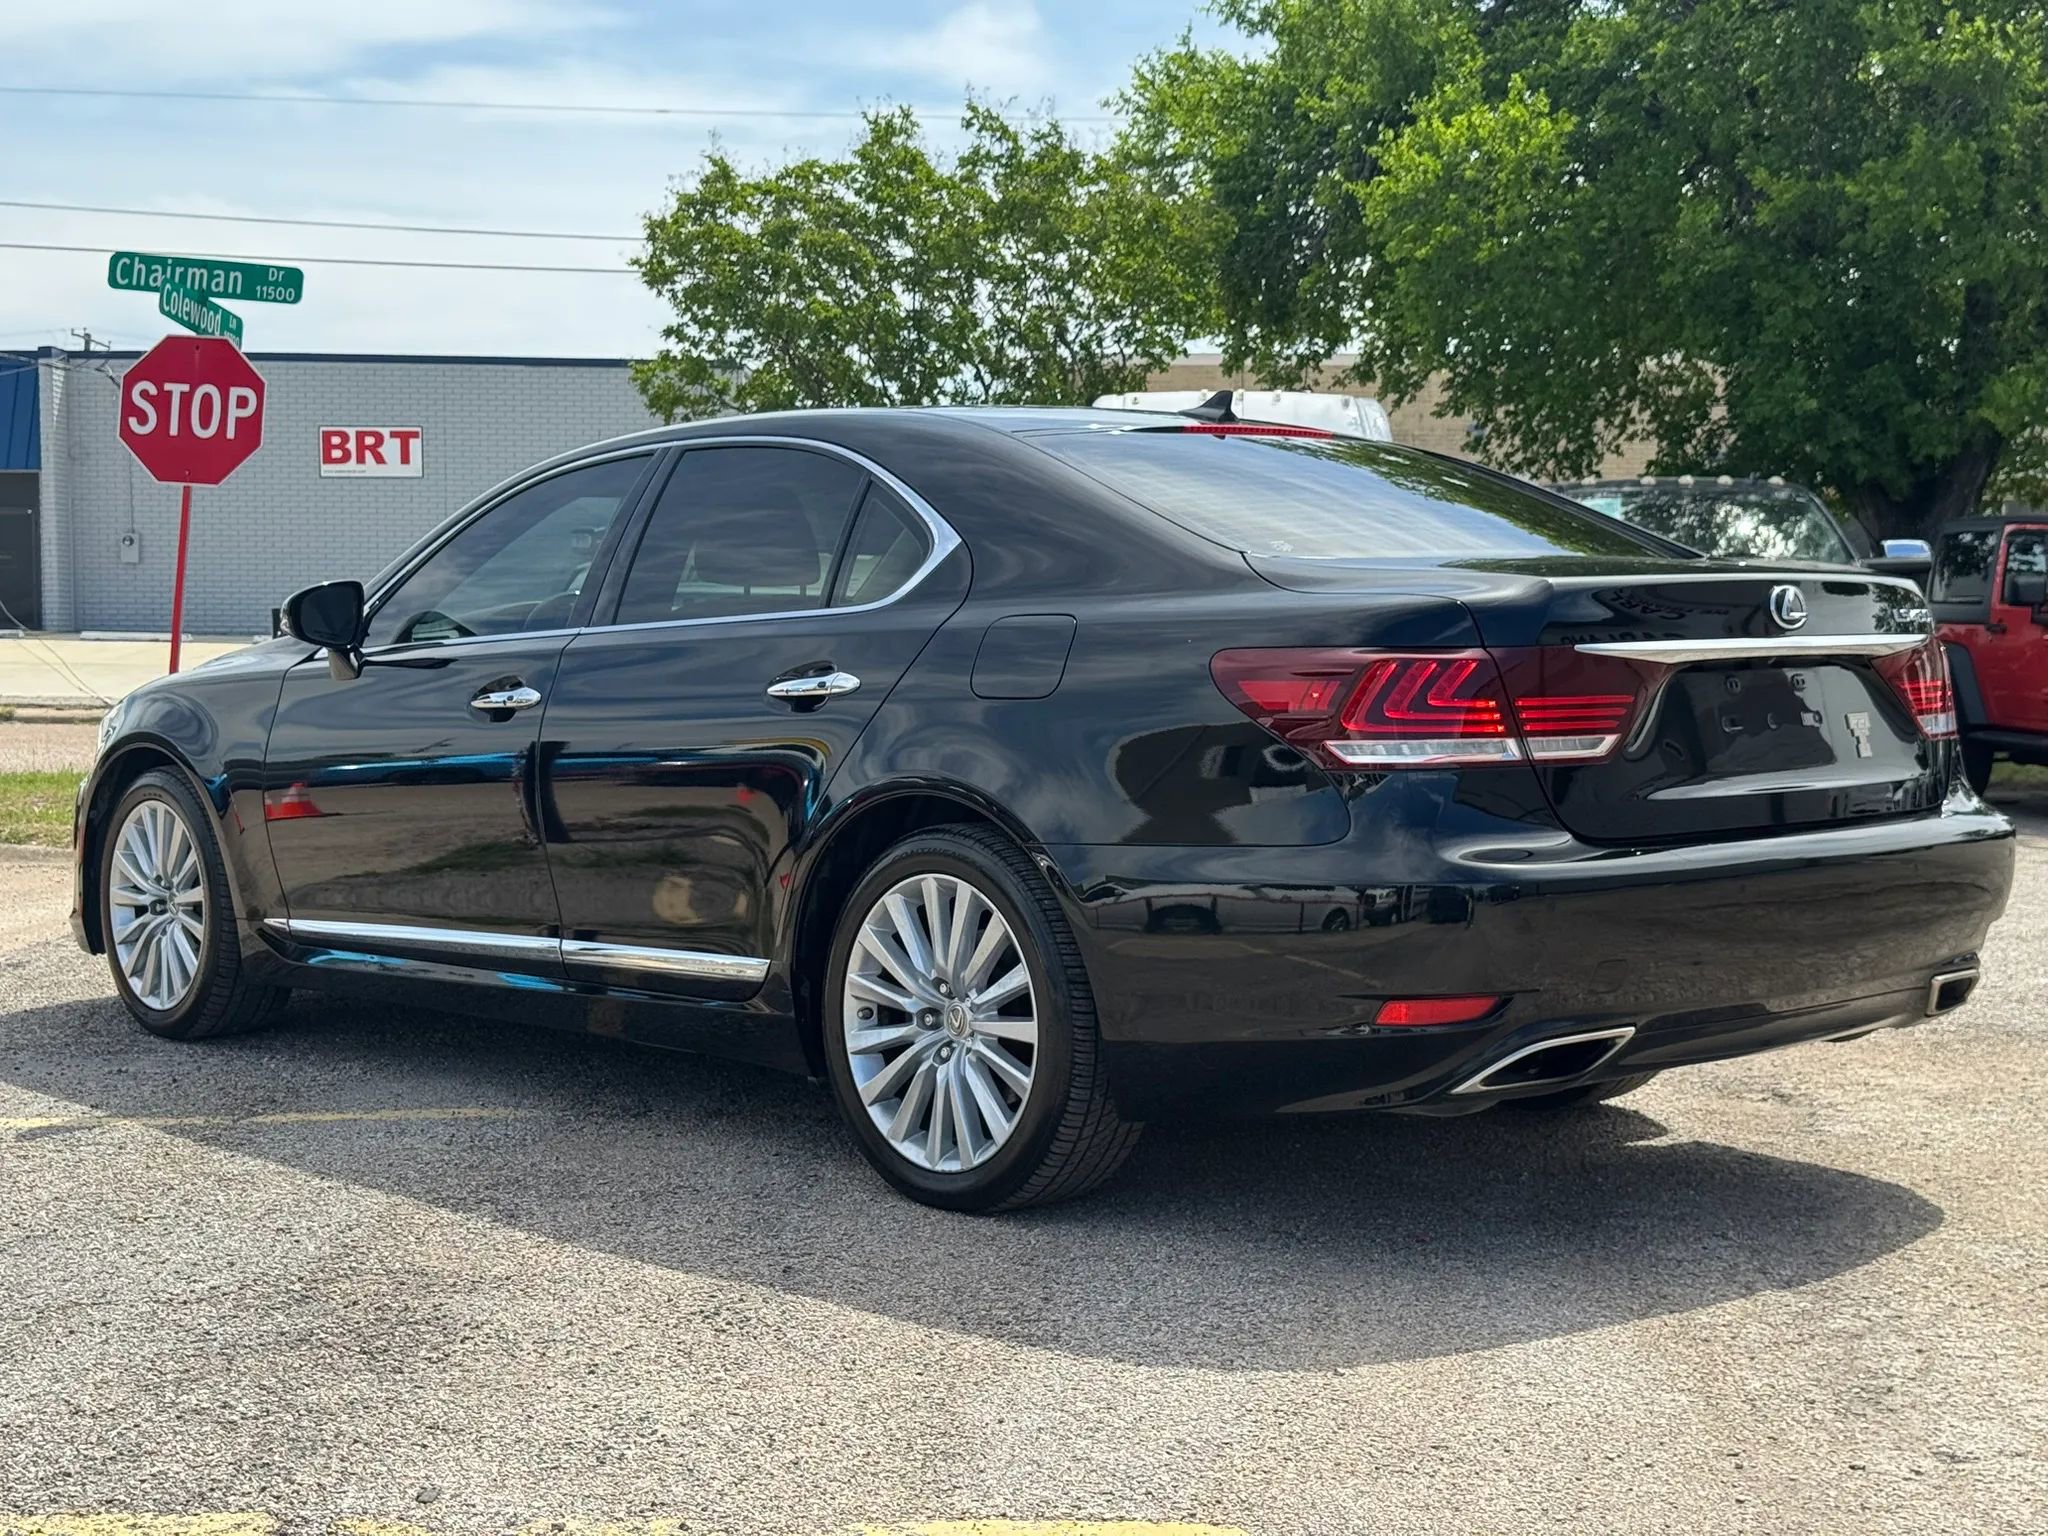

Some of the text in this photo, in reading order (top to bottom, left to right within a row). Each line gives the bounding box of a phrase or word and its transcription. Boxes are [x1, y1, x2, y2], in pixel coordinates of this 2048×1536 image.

[115, 256, 286, 295] Chairman Dr
[255, 285, 296, 302] 11500
[162, 282, 223, 336] Colewood
[128, 380, 258, 440] STOP
[321, 430, 421, 466] BRT
